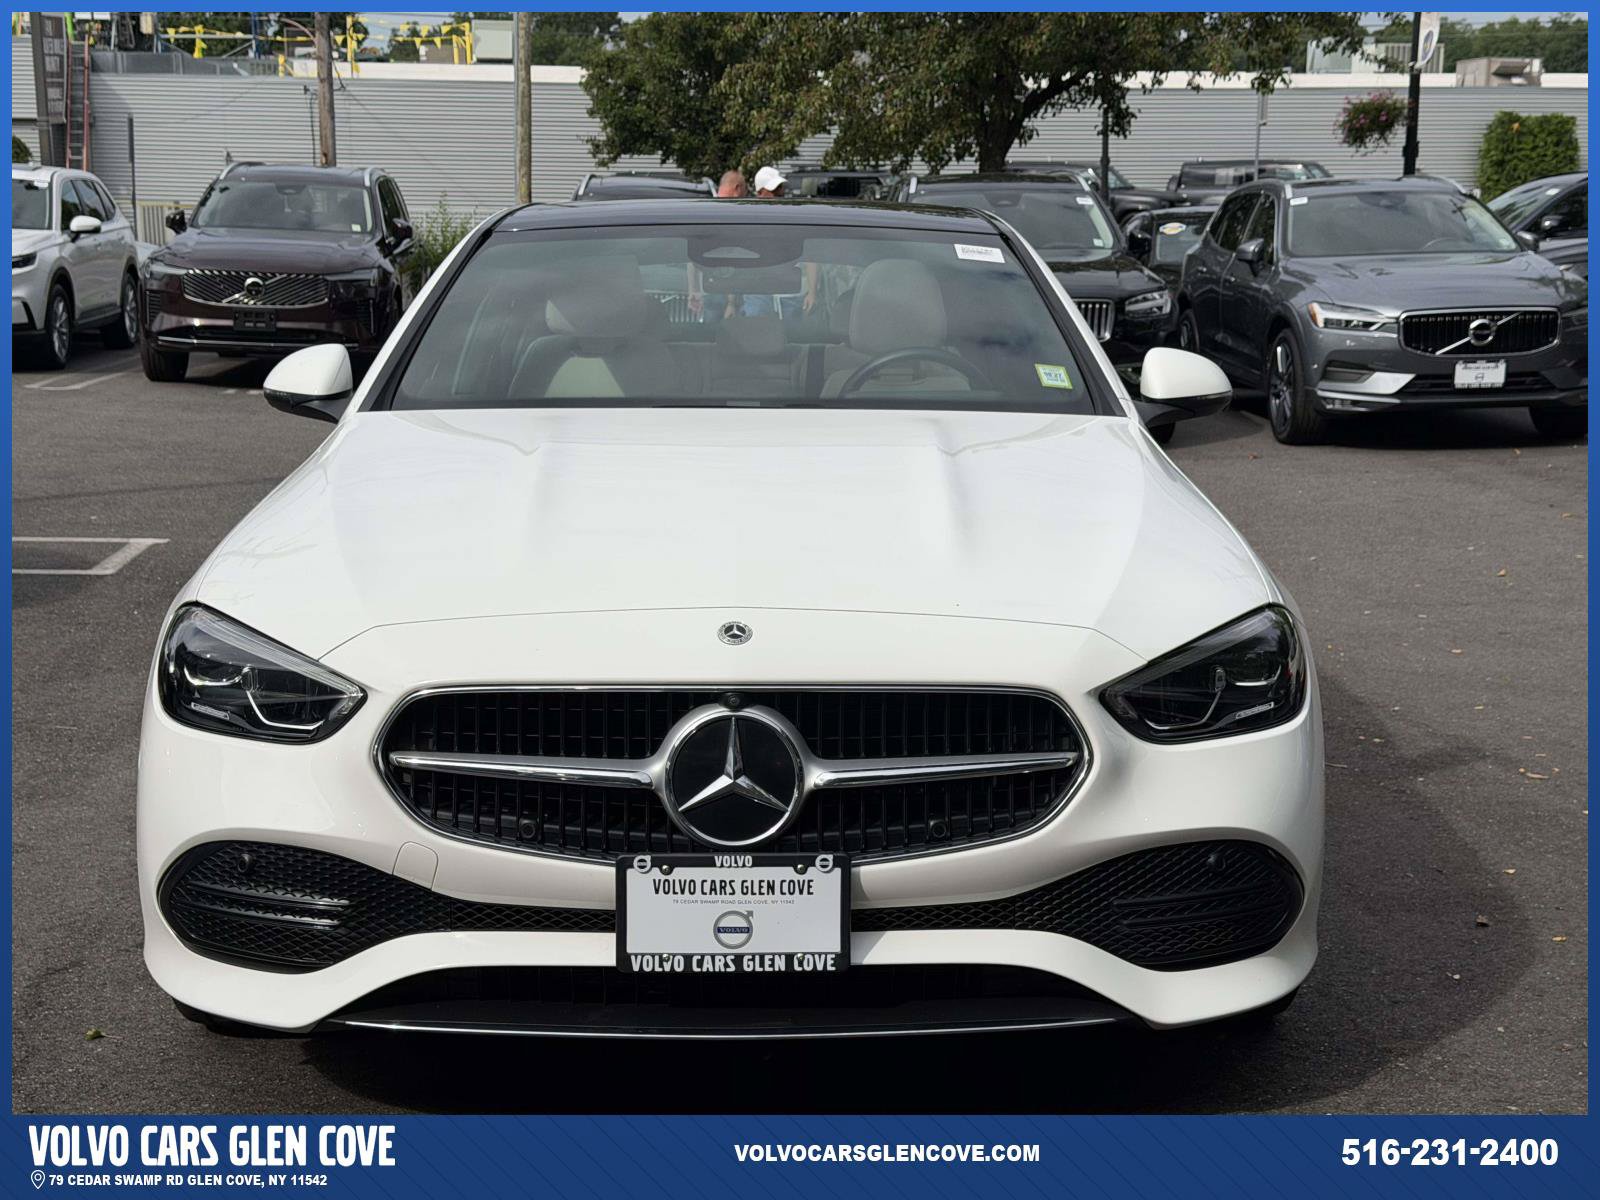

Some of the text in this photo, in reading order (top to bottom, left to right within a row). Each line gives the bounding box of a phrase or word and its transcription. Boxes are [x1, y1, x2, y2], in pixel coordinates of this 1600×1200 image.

[714, 855, 753, 867] VOLVO
[652, 879, 814, 896] VOLVO CARS GLEN COVE
[630, 954, 836, 972] VOLVO CARS GLEN COVE
